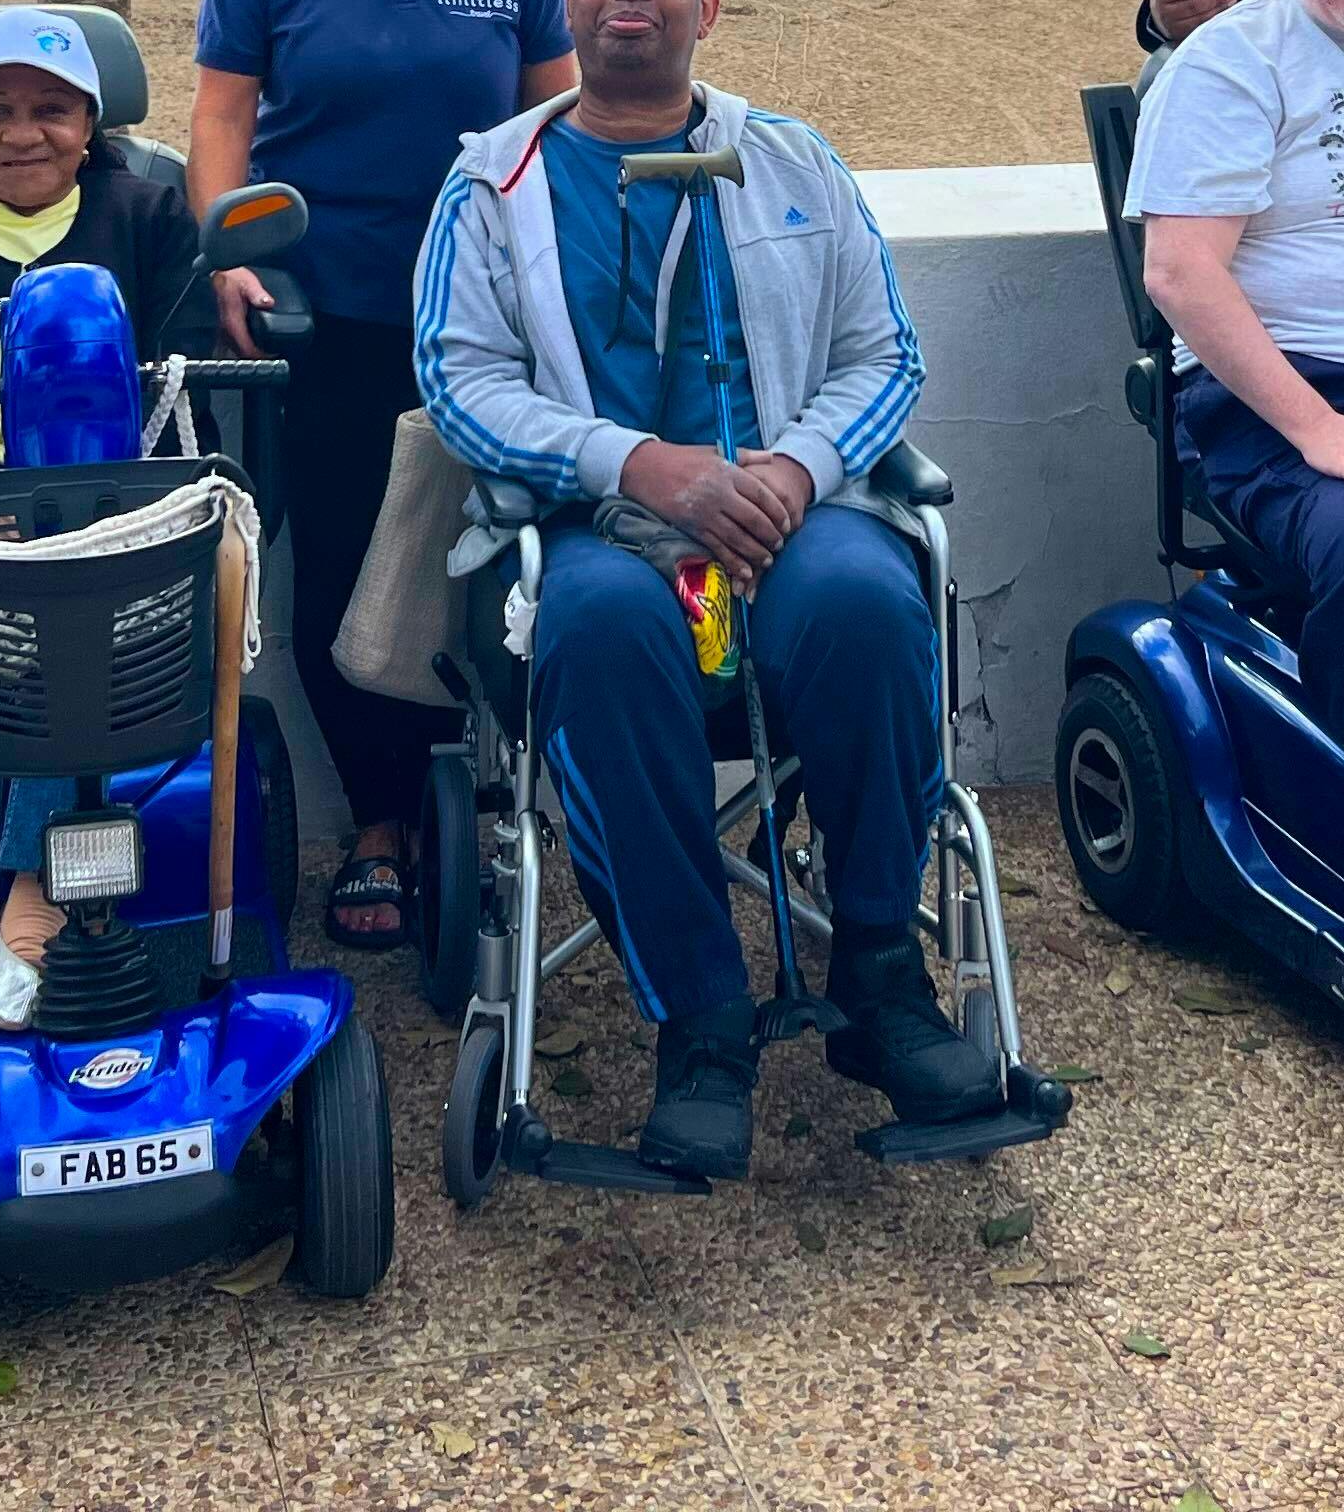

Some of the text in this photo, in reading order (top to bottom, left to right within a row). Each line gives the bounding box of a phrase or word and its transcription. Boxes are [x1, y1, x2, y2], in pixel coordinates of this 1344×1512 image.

[71, 1058, 152, 1081] Strider
[60, 1139, 178, 1186] FAB 65
